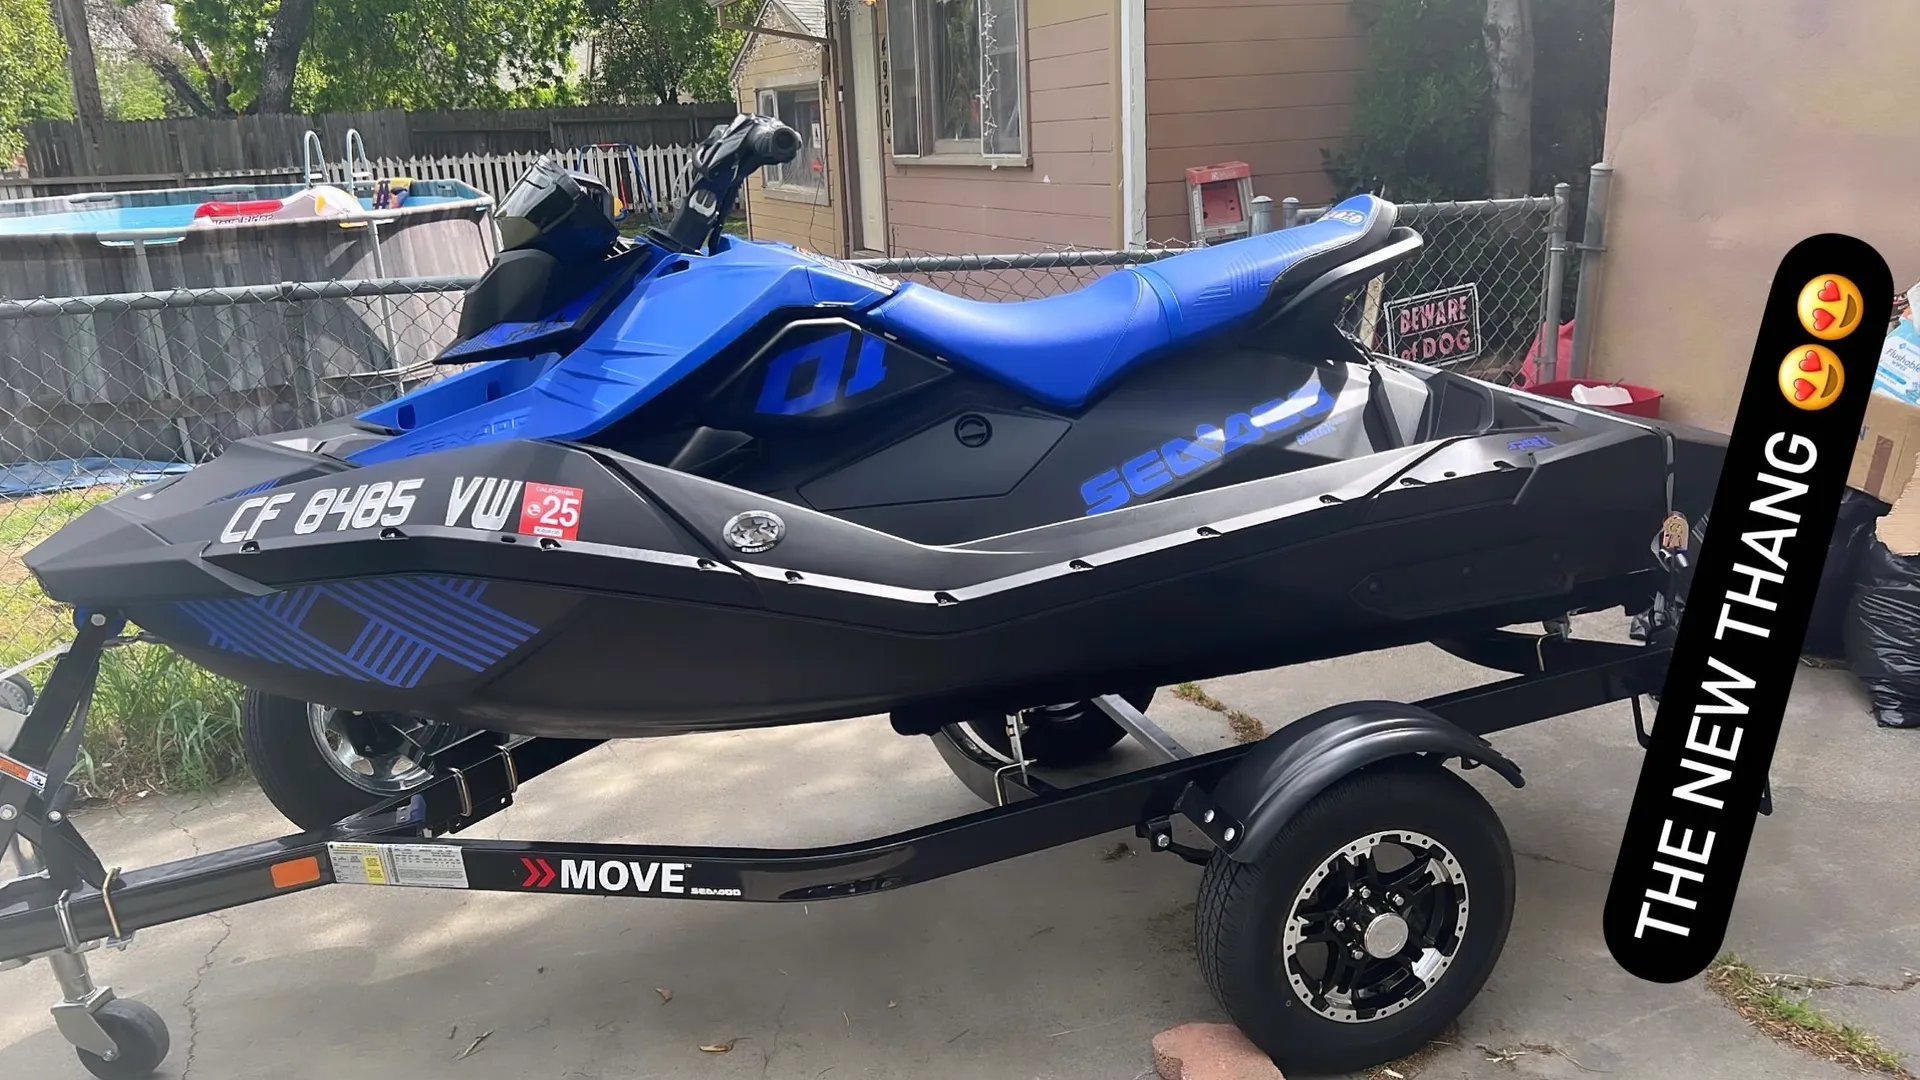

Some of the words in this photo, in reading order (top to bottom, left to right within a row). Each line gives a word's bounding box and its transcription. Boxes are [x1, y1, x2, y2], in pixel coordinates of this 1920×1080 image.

[1400, 296, 1467, 333] BEWARE
[1401, 341, 1418, 361] of
[1423, 328, 1471, 359] DOG
[535, 485, 575, 497] CALIFORNIA
[220, 493, 296, 543] CF
[294, 478, 425, 535] 8485
[445, 476, 523, 531] VW
[540, 494, 578, 528] 25
[561, 859, 685, 893] MOVE
